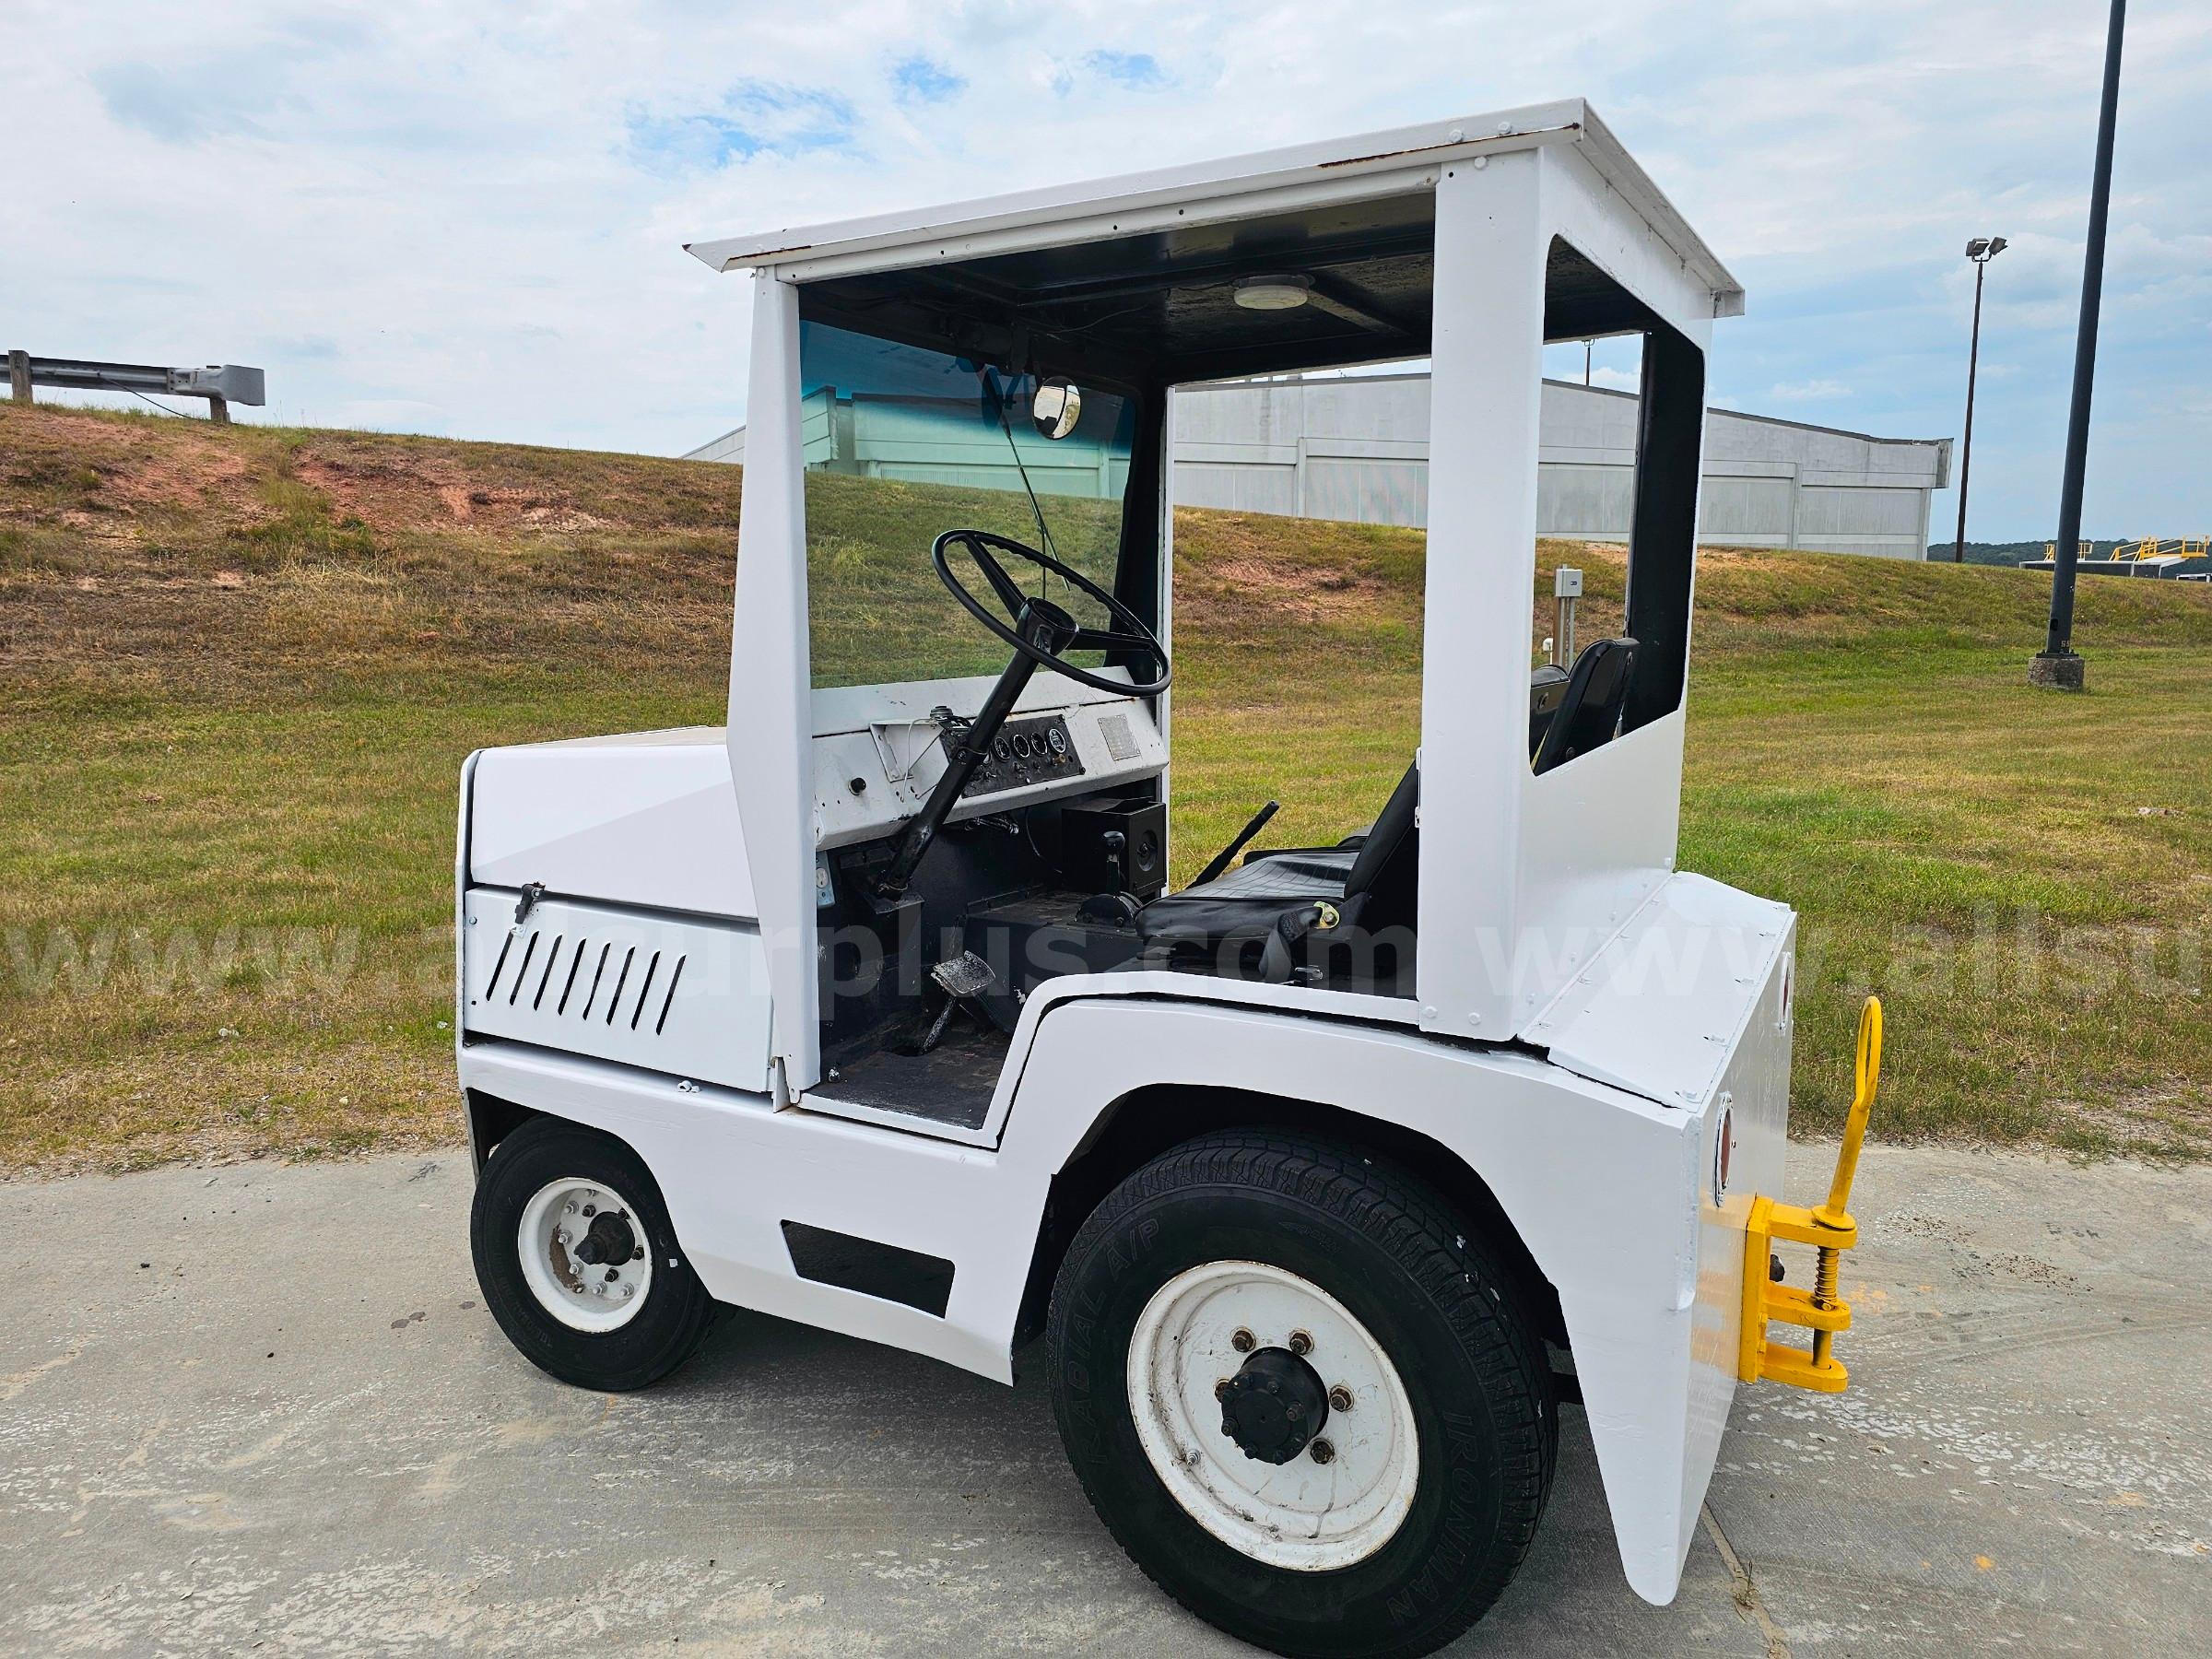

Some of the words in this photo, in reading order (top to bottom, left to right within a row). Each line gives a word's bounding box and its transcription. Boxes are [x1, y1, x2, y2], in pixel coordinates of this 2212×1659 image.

[1064, 1290, 1111, 1465] RADIAL
[1108, 1217, 1162, 1283] A/P
[1385, 1408, 1487, 1627] IRONMAN
